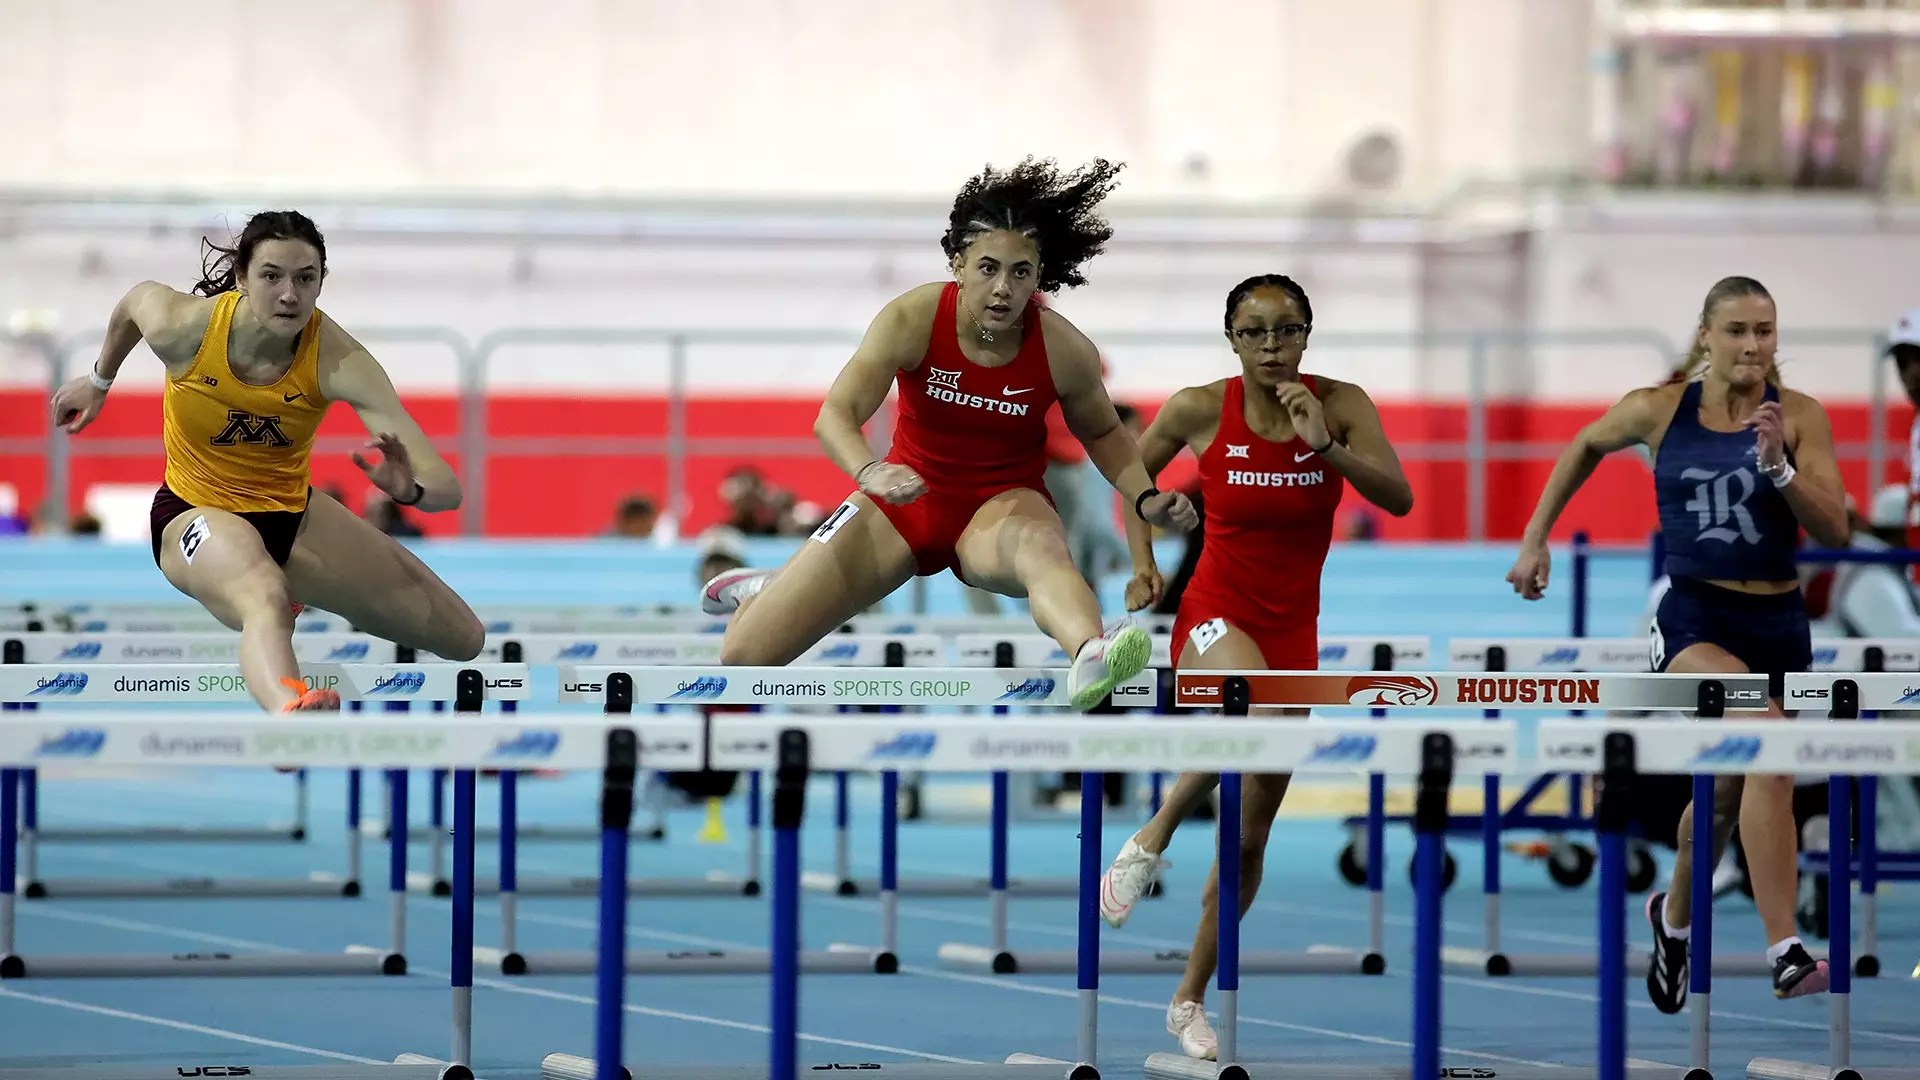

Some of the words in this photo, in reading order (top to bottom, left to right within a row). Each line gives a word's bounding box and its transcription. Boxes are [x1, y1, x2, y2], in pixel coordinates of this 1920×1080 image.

[926, 384, 1029, 416] HOUSTON
[210, 410, 293, 447] M
[1226, 470, 1324, 487] HOUSTON
[37, 677, 86, 688] dunamis
[114, 676, 190, 692] dunamis
[198, 676, 245, 692] SPOR
[303, 676, 339, 690] OUP
[375, 676, 422, 687] dunamis
[485, 679, 523, 688] UCS
[677, 680, 724, 692] dunamis
[1005, 681, 1052, 692] dunamis
[564, 683, 602, 692] UCS
[752, 680, 826, 696] dunamis
[833, 680, 903, 697] SPORTS
[911, 680, 970, 697] GROUP
[1113, 686, 1150, 695] UCS
[1182, 686, 1219, 695] UCS
[1457, 678, 1600, 703] HOUSTON
[1725, 690, 1761, 699] UCS
[1791, 689, 1829, 698] UCS
[177, 1066, 251, 1077] UCS
